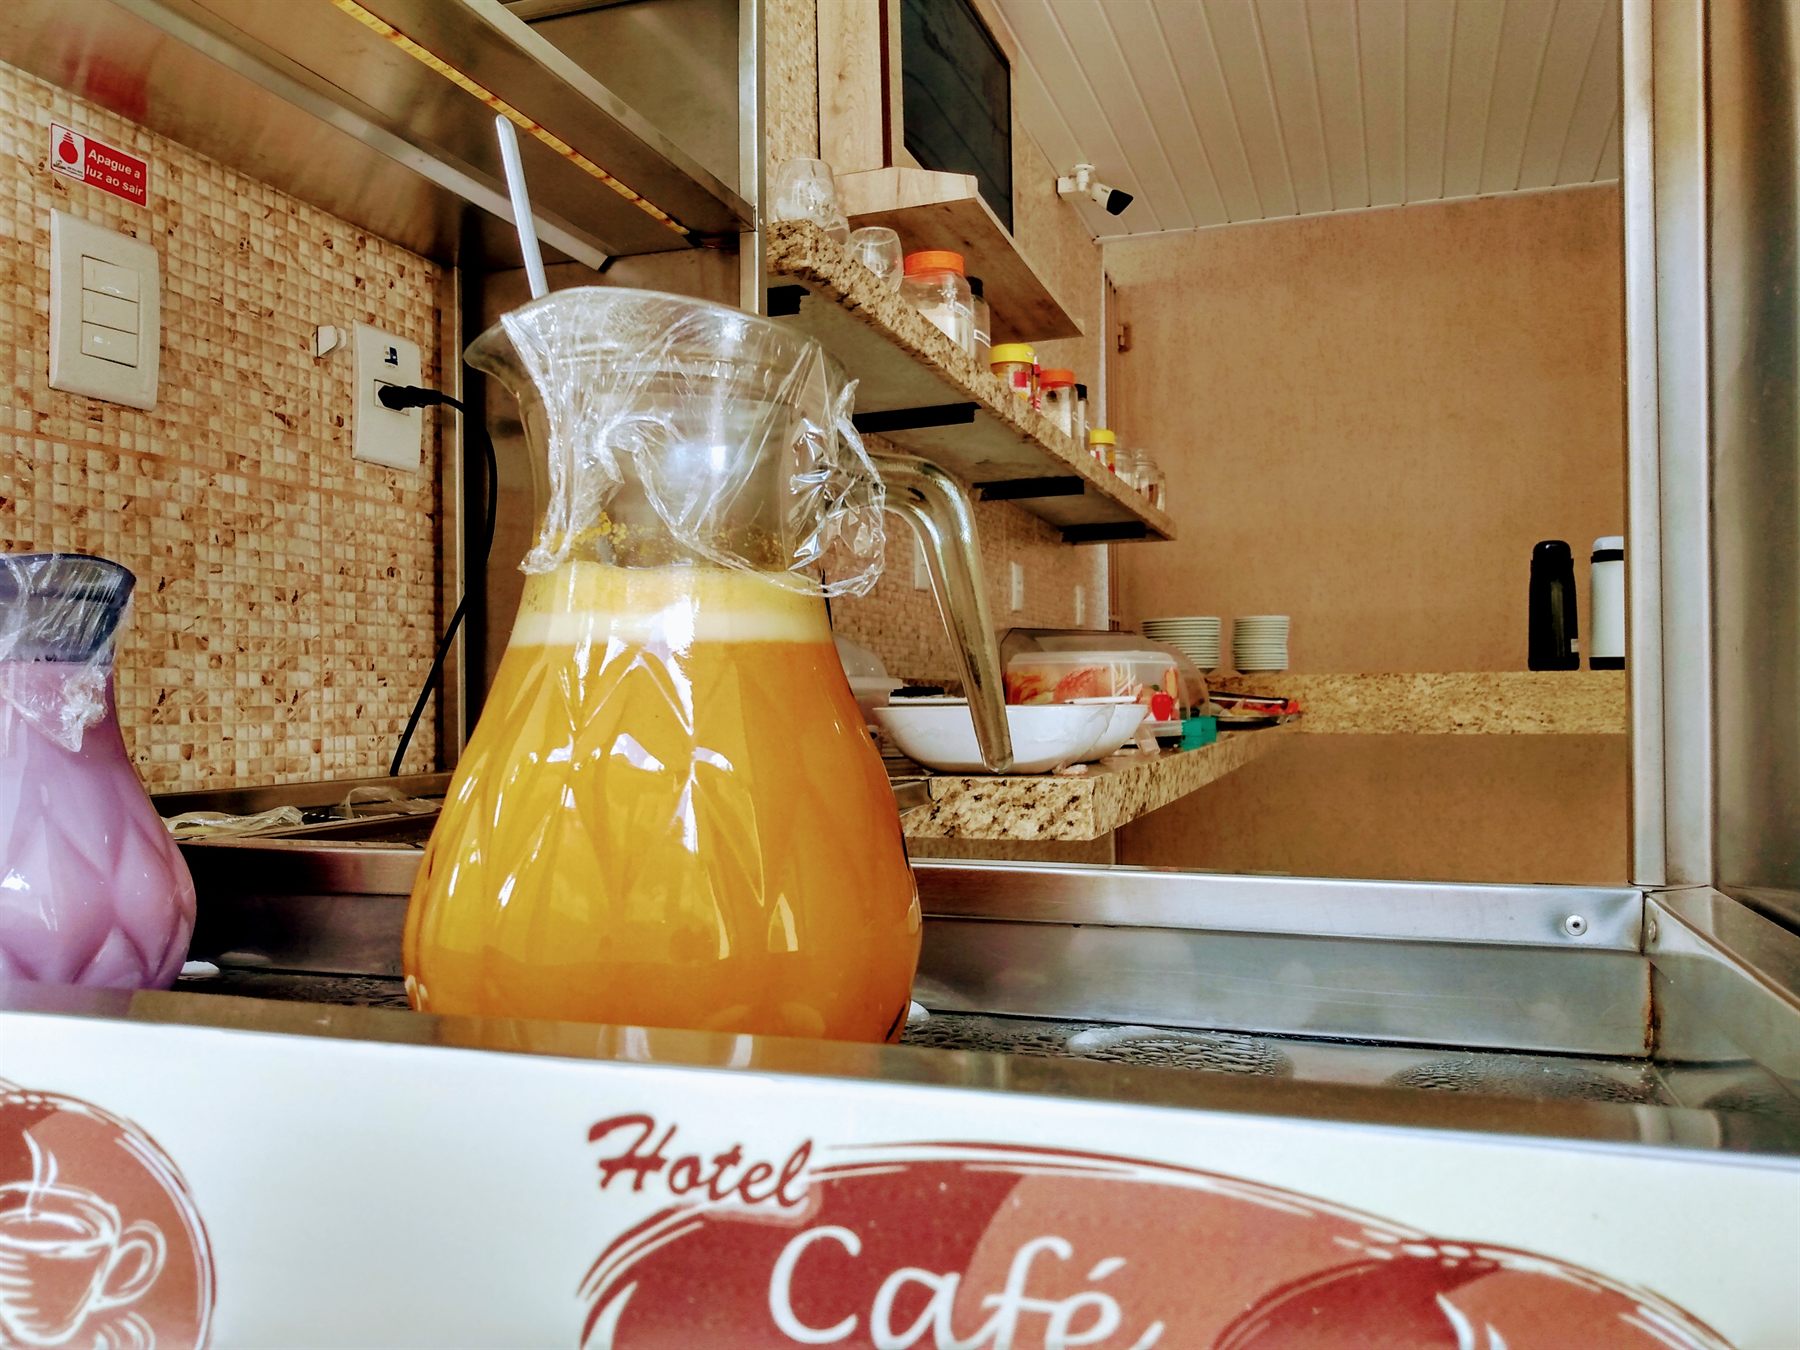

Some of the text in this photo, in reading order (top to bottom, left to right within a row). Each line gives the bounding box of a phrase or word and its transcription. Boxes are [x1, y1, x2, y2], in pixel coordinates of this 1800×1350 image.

[86, 165, 103, 180] luz
[105, 175, 120, 187] ao
[122, 181, 144, 197] sair
[88, 149, 132, 175] Apague
[134, 170, 141, 179] a
[588, 1113, 812, 1207] Hotel
[769, 1225, 1164, 1350] Café
